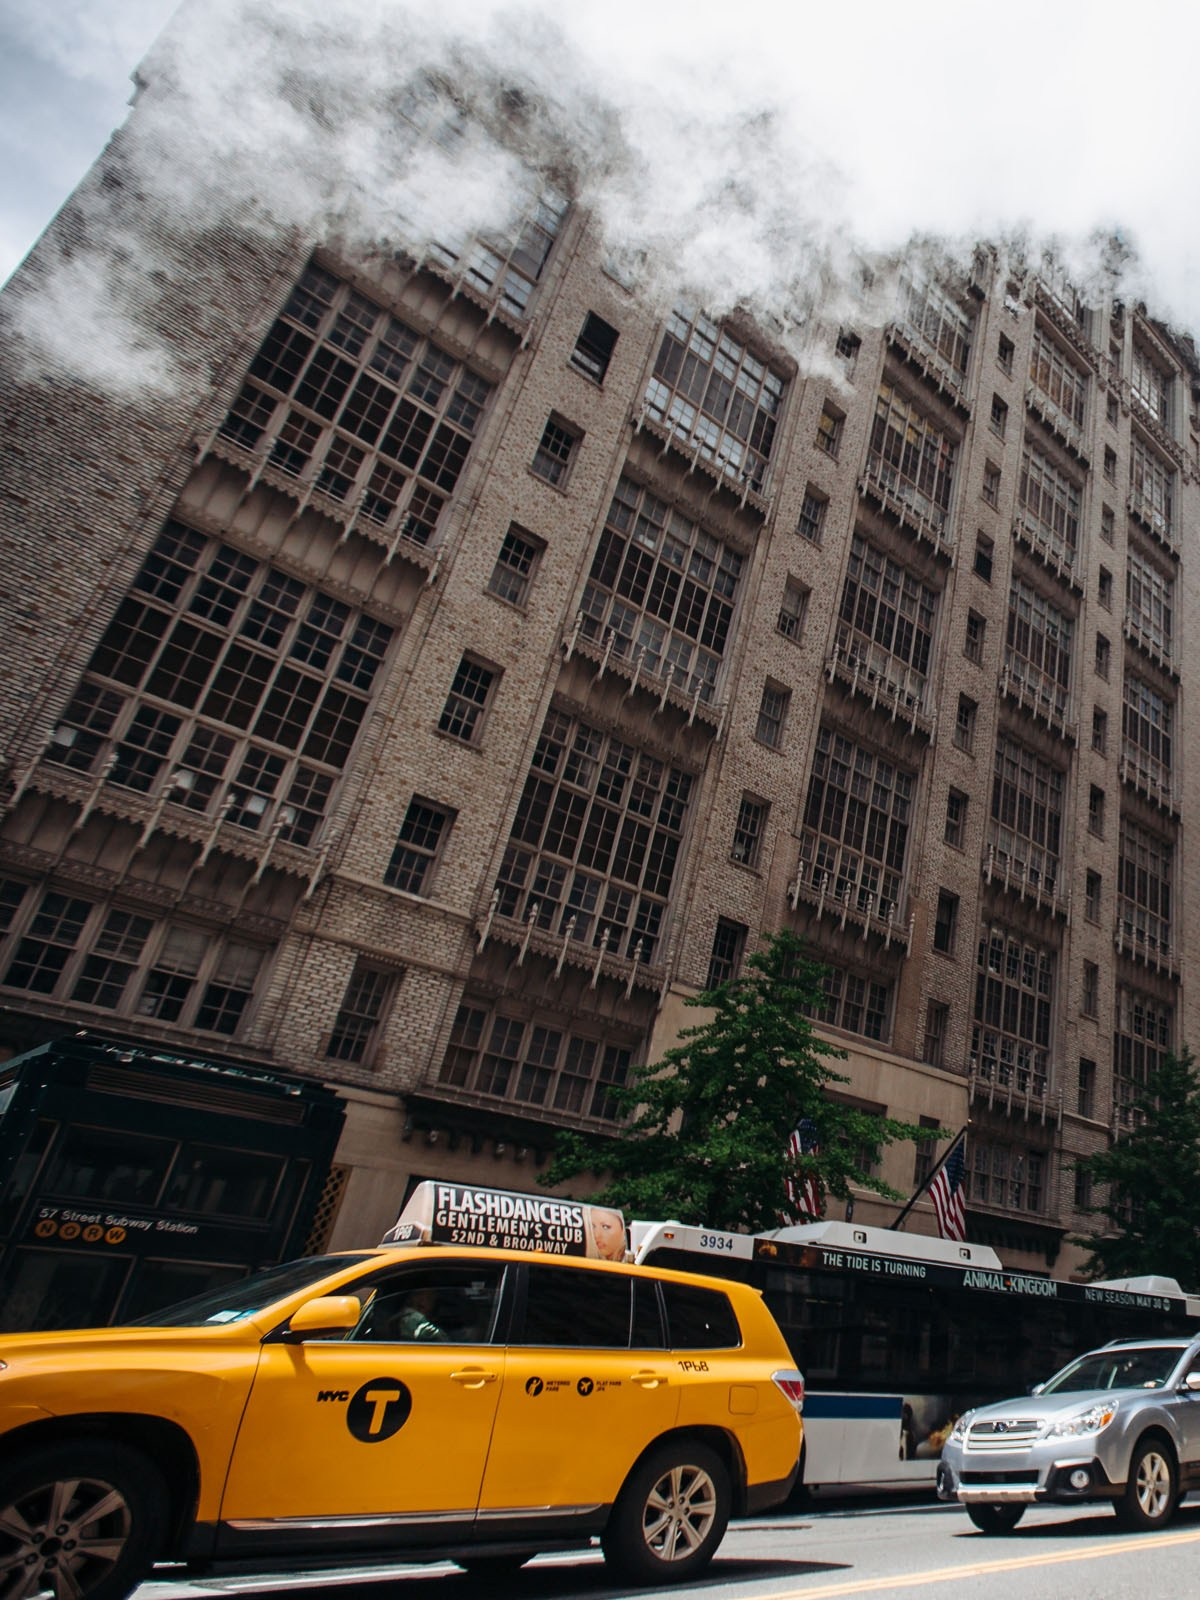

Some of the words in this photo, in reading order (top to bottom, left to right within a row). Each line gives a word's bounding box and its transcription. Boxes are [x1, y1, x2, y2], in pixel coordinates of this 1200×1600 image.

[437, 1186, 584, 1228] FLASHDANCERS
[39, 1208, 58, 1219] 57
[60, 1210, 102, 1224] Street
[104, 1214, 154, 1231] Subway
[155, 1219, 200, 1234] Station
[436, 1210, 543, 1239] GENTLEMEN'S
[547, 1225, 583, 1244] CLUB
[451, 1230, 485, 1245] 52ND
[489, 1234, 499, 1247] &
[503, 1236, 568, 1254] BROADWAY
[700, 1234, 734, 1251] 3934
[822, 1252, 843, 1267] THE
[846, 1255, 869, 1271] TIDE
[871, 1259, 881, 1272] IS
[884, 1261, 927, 1279] TURNING
[963, 1270, 1007, 1291] ANIMAL
[1009, 1277, 1057, 1297] KINGDOM
[1084, 1288, 1104, 1302] NEW
[1105, 1291, 1136, 1306] SEASON
[1136, 1295, 1153, 1308] MAY
[317, 1391, 350, 1402] NYC
[365, 1389, 400, 1435] T
